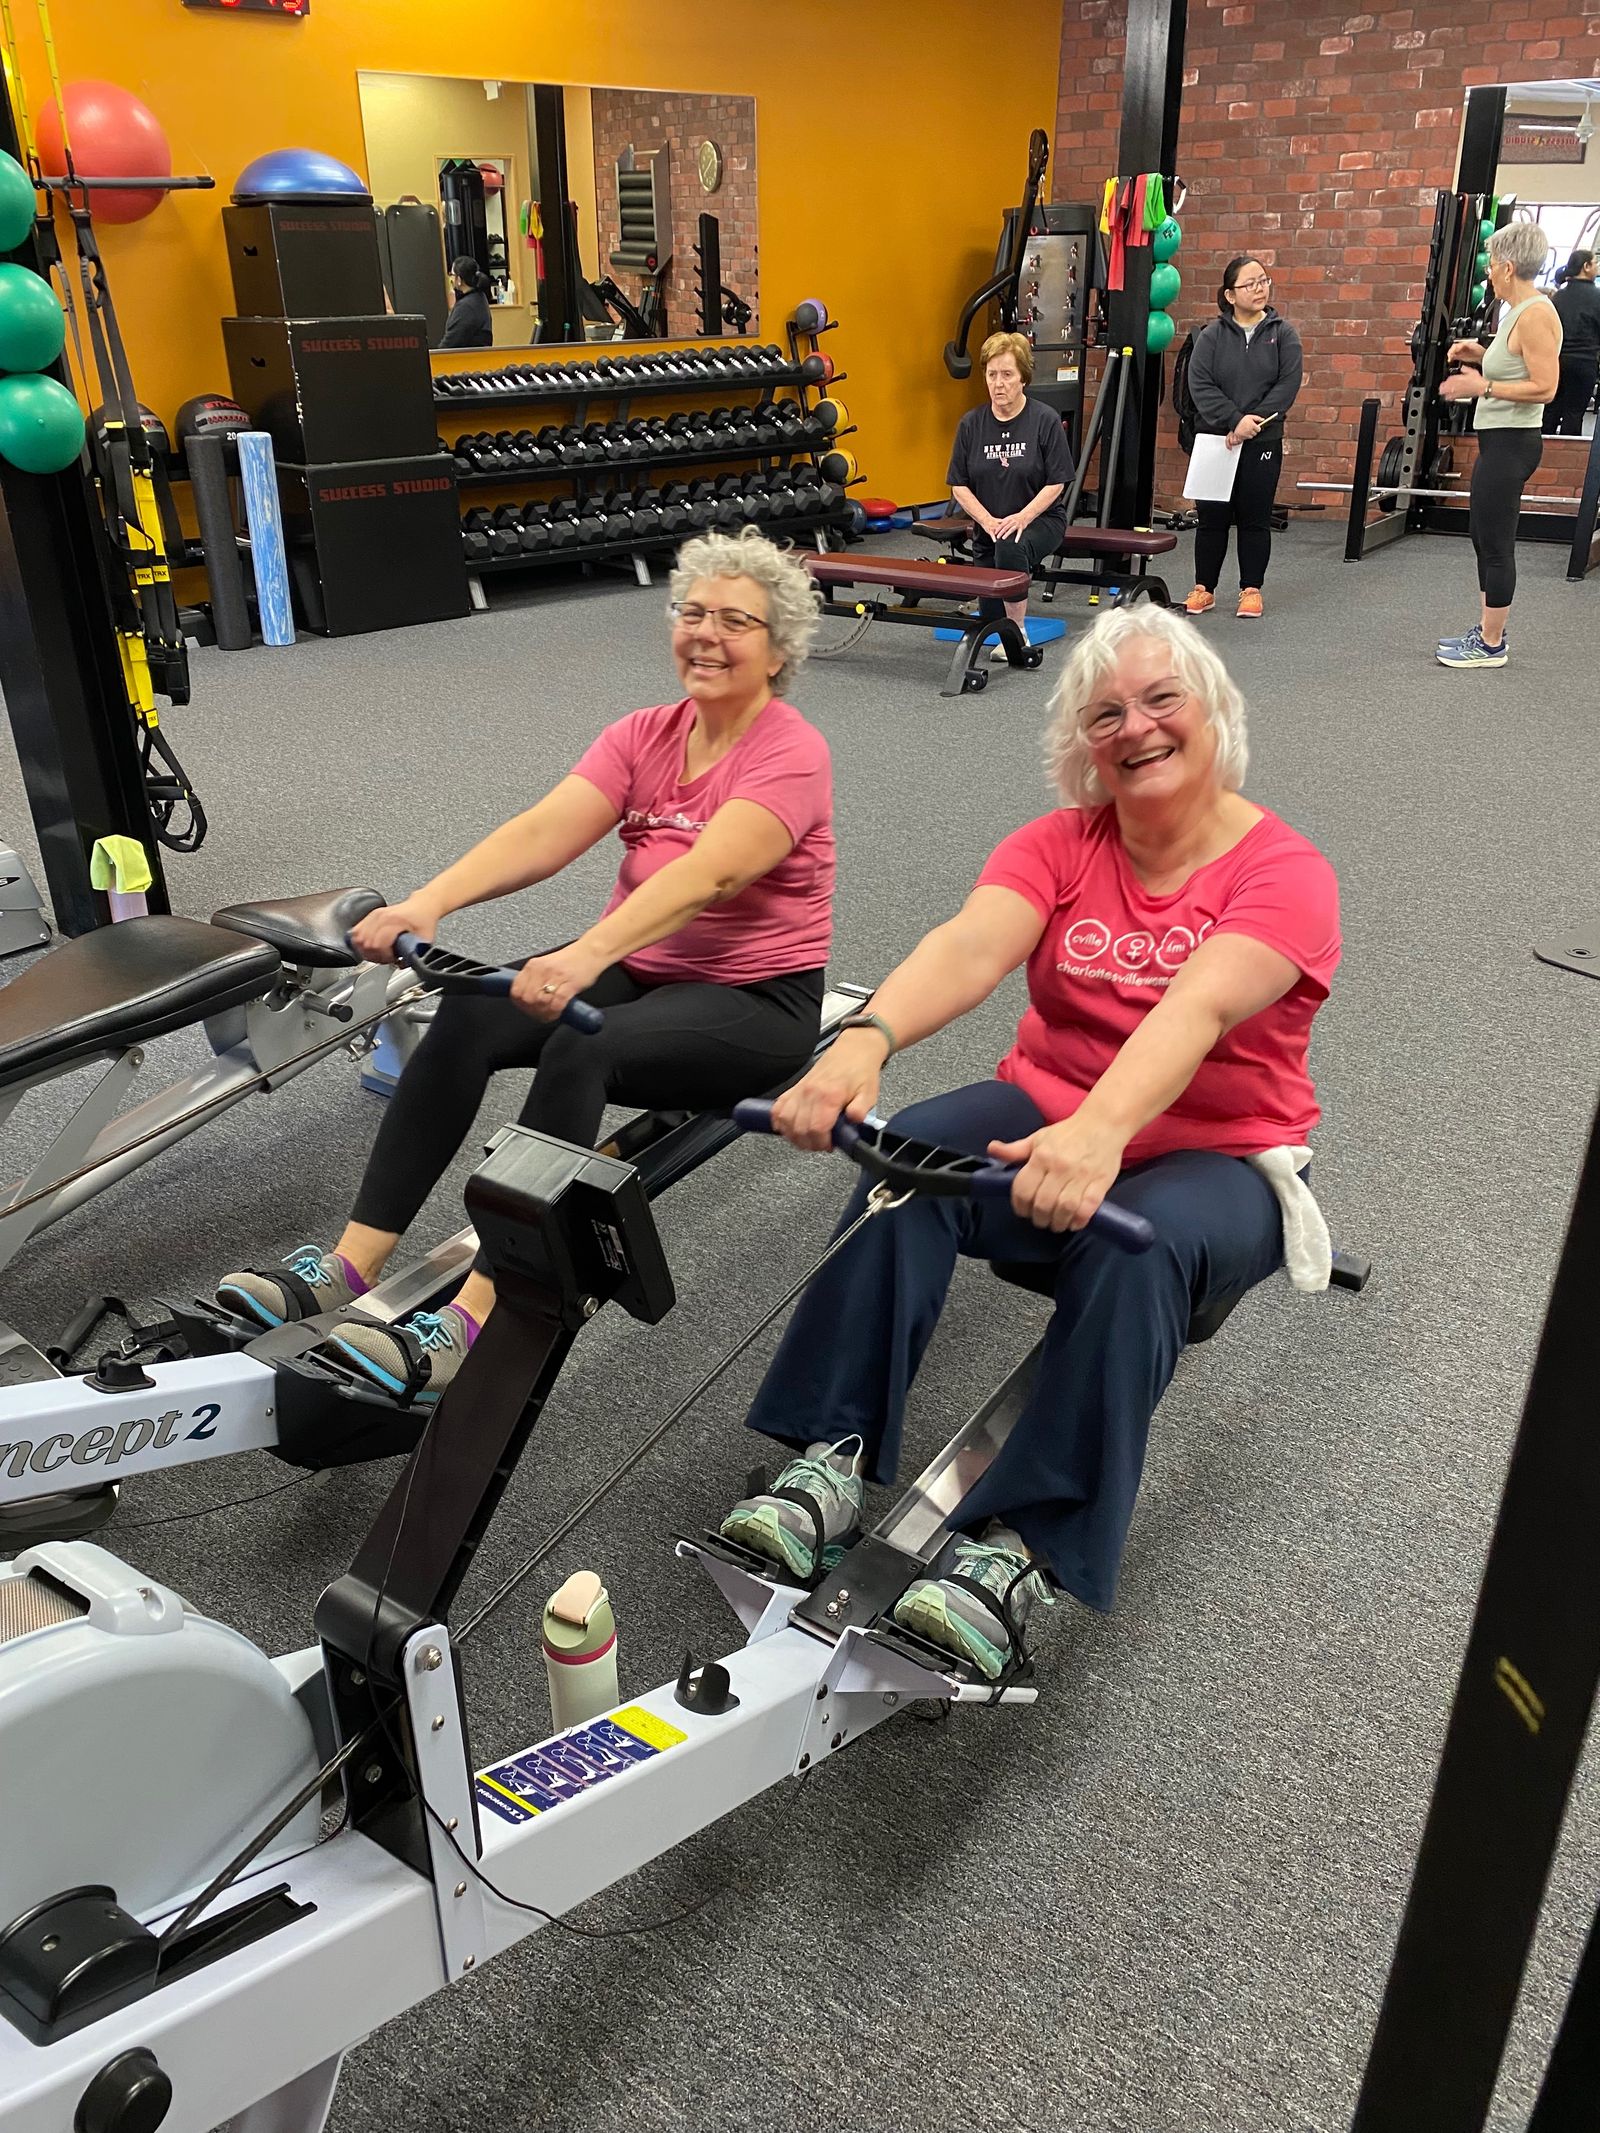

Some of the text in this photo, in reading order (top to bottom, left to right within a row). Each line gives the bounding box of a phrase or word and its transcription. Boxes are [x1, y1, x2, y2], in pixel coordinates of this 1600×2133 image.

[301, 336, 419, 353] SUCCESS STUDIO
[984, 442, 1026, 453] NEW YORK
[319, 477, 450, 502] SUCCESS STUDIO
[1072, 933, 1103, 947] cville
